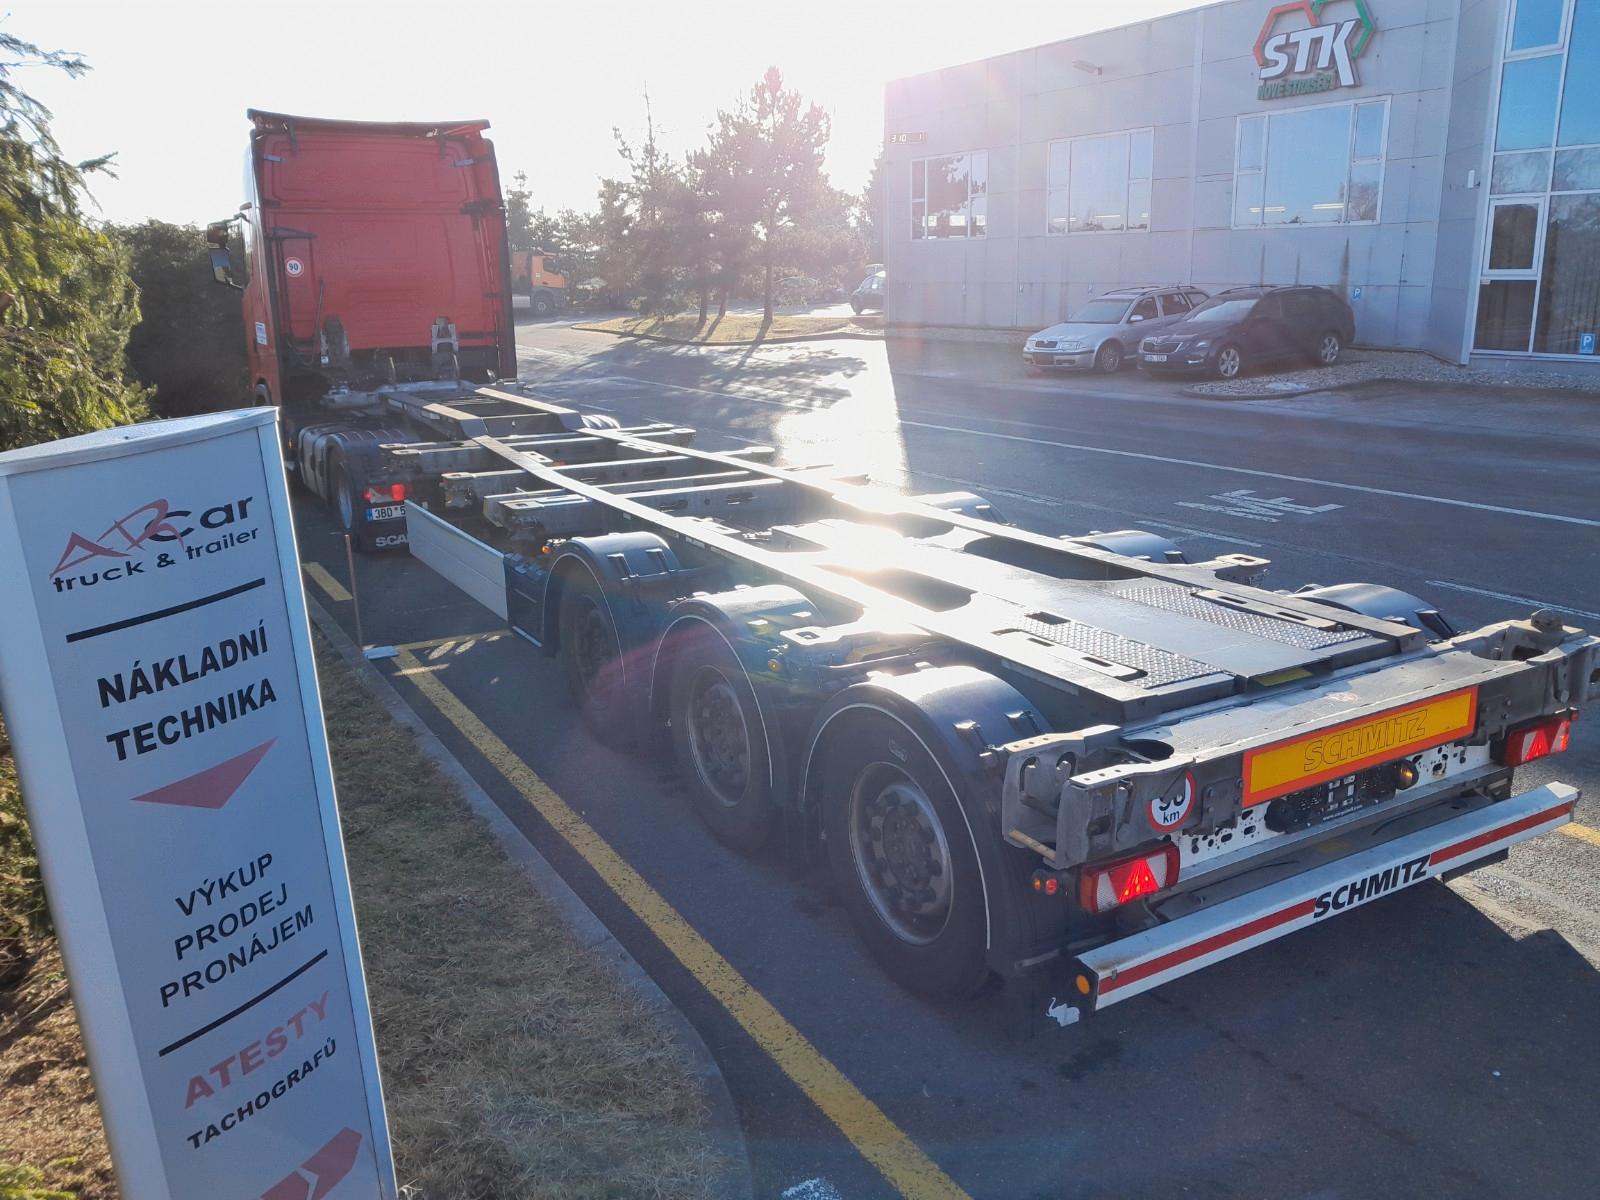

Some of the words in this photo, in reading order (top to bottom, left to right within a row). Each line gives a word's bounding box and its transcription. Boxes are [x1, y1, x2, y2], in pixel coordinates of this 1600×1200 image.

[1258, 18, 1361, 86] STK
[289, 263, 298, 272] 90
[1584, 336, 1592, 346] P
[374, 507, 393, 518] 3BD
[376, 534, 408, 548] SCA
[53, 561, 144, 592] truck
[157, 553, 176, 568] &
[185, 528, 259, 560] trailer
[96, 619, 269, 709] NÁKLADNÍ
[106, 678, 278, 762] TECHNIKA
[1304, 708, 1428, 772] SCHMITZ
[1163, 811, 1180, 824] km
[175, 853, 274, 917] VÝKUP
[1313, 853, 1431, 919] SCHMITZ
[174, 882, 289, 960] PRODEJ
[159, 904, 315, 1008] PRONÁJEM
[183, 991, 331, 1110] ATESTY
[186, 1037, 338, 1150] TACHOGRAFŮ
